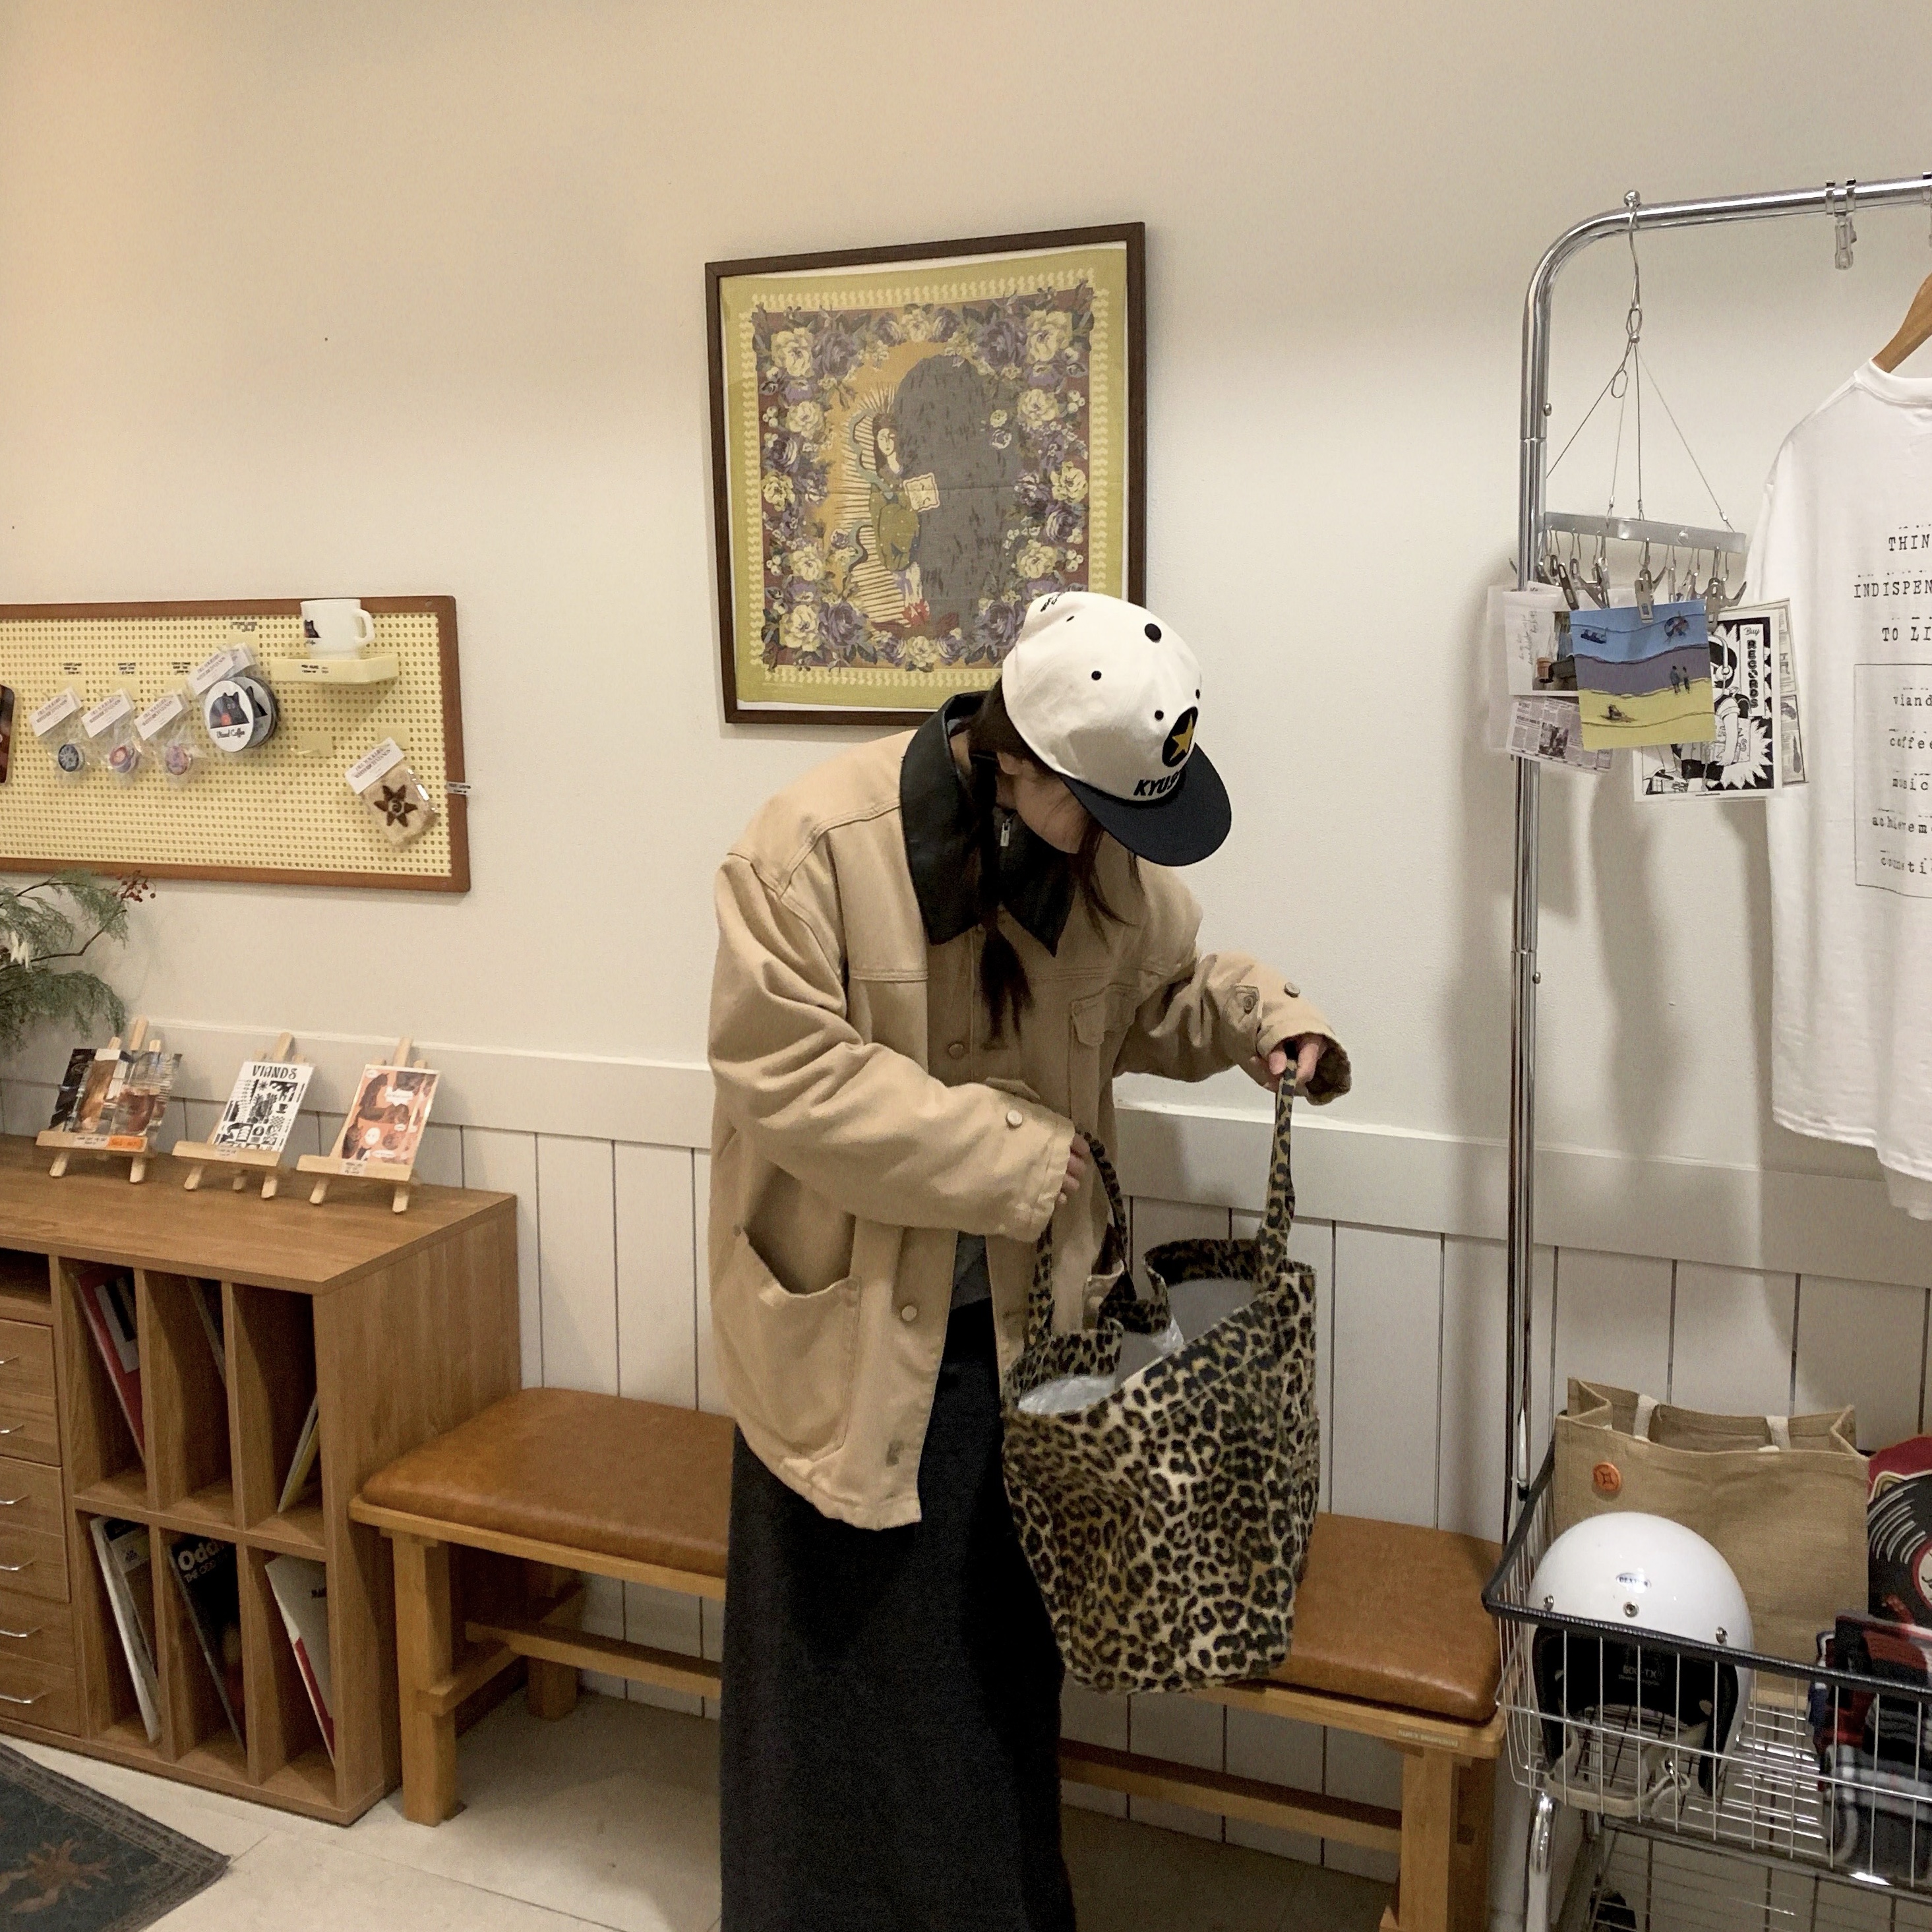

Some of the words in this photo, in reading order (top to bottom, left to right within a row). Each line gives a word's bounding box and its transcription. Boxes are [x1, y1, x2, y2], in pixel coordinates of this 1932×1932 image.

[1888, 533, 1930, 551] THIN
[1854, 579, 1932, 598] INDISPEN
[1743, 627, 1760, 637] Buy
[1881, 627, 1899, 642] TO
[1910, 626, 1932, 642] LI
[1747, 639, 1759, 709] RECORDS
[1872, 816, 1932, 834] achievem
[253, 1065, 297, 1079] VIANDS
